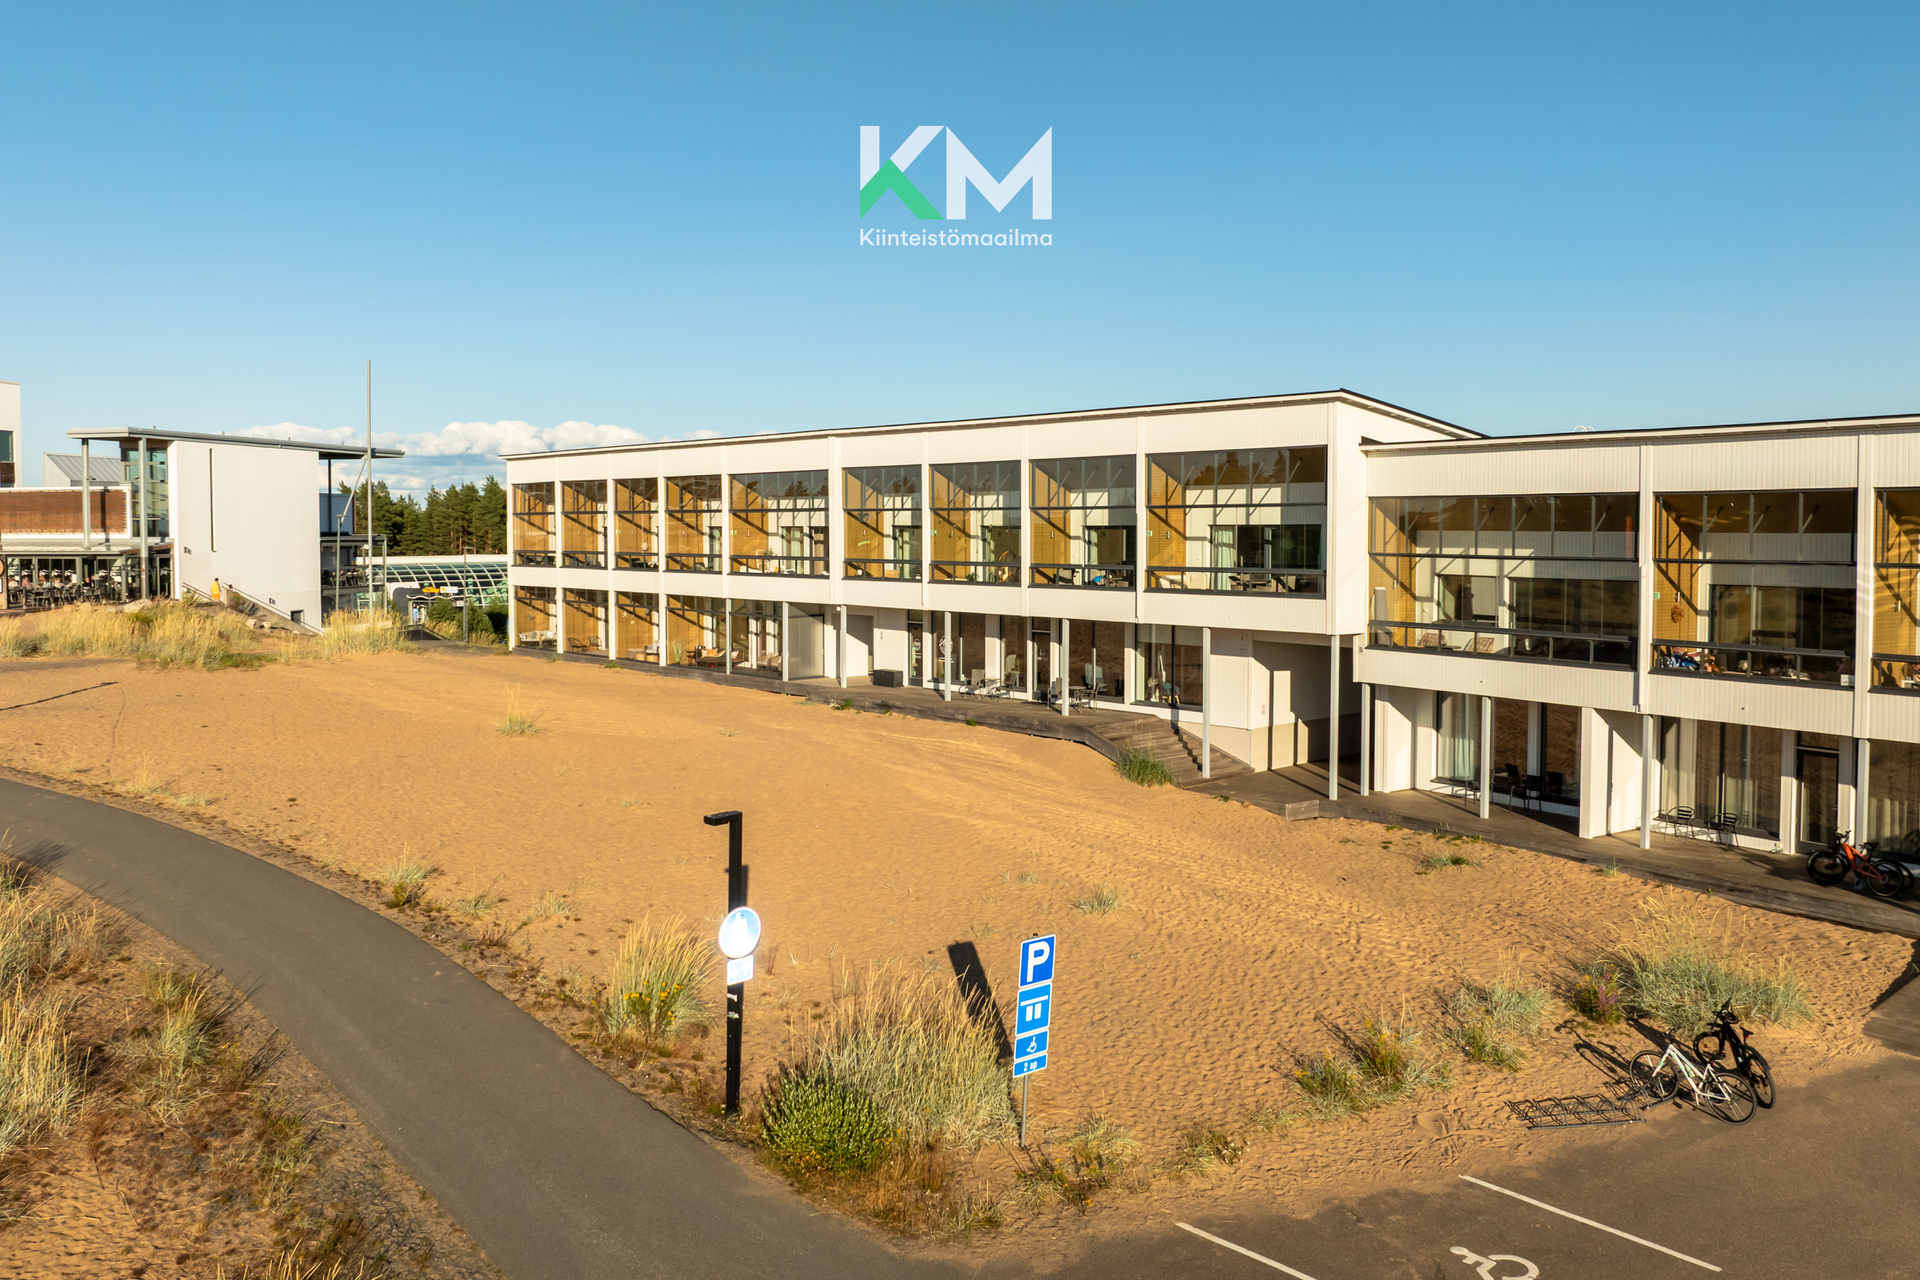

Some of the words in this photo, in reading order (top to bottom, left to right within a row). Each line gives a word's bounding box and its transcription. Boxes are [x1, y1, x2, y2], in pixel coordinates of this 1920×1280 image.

[1026, 941, 1050, 983] P
[1023, 1062, 1029, 1071] 2
[1029, 1061, 1038, 1071] ap
